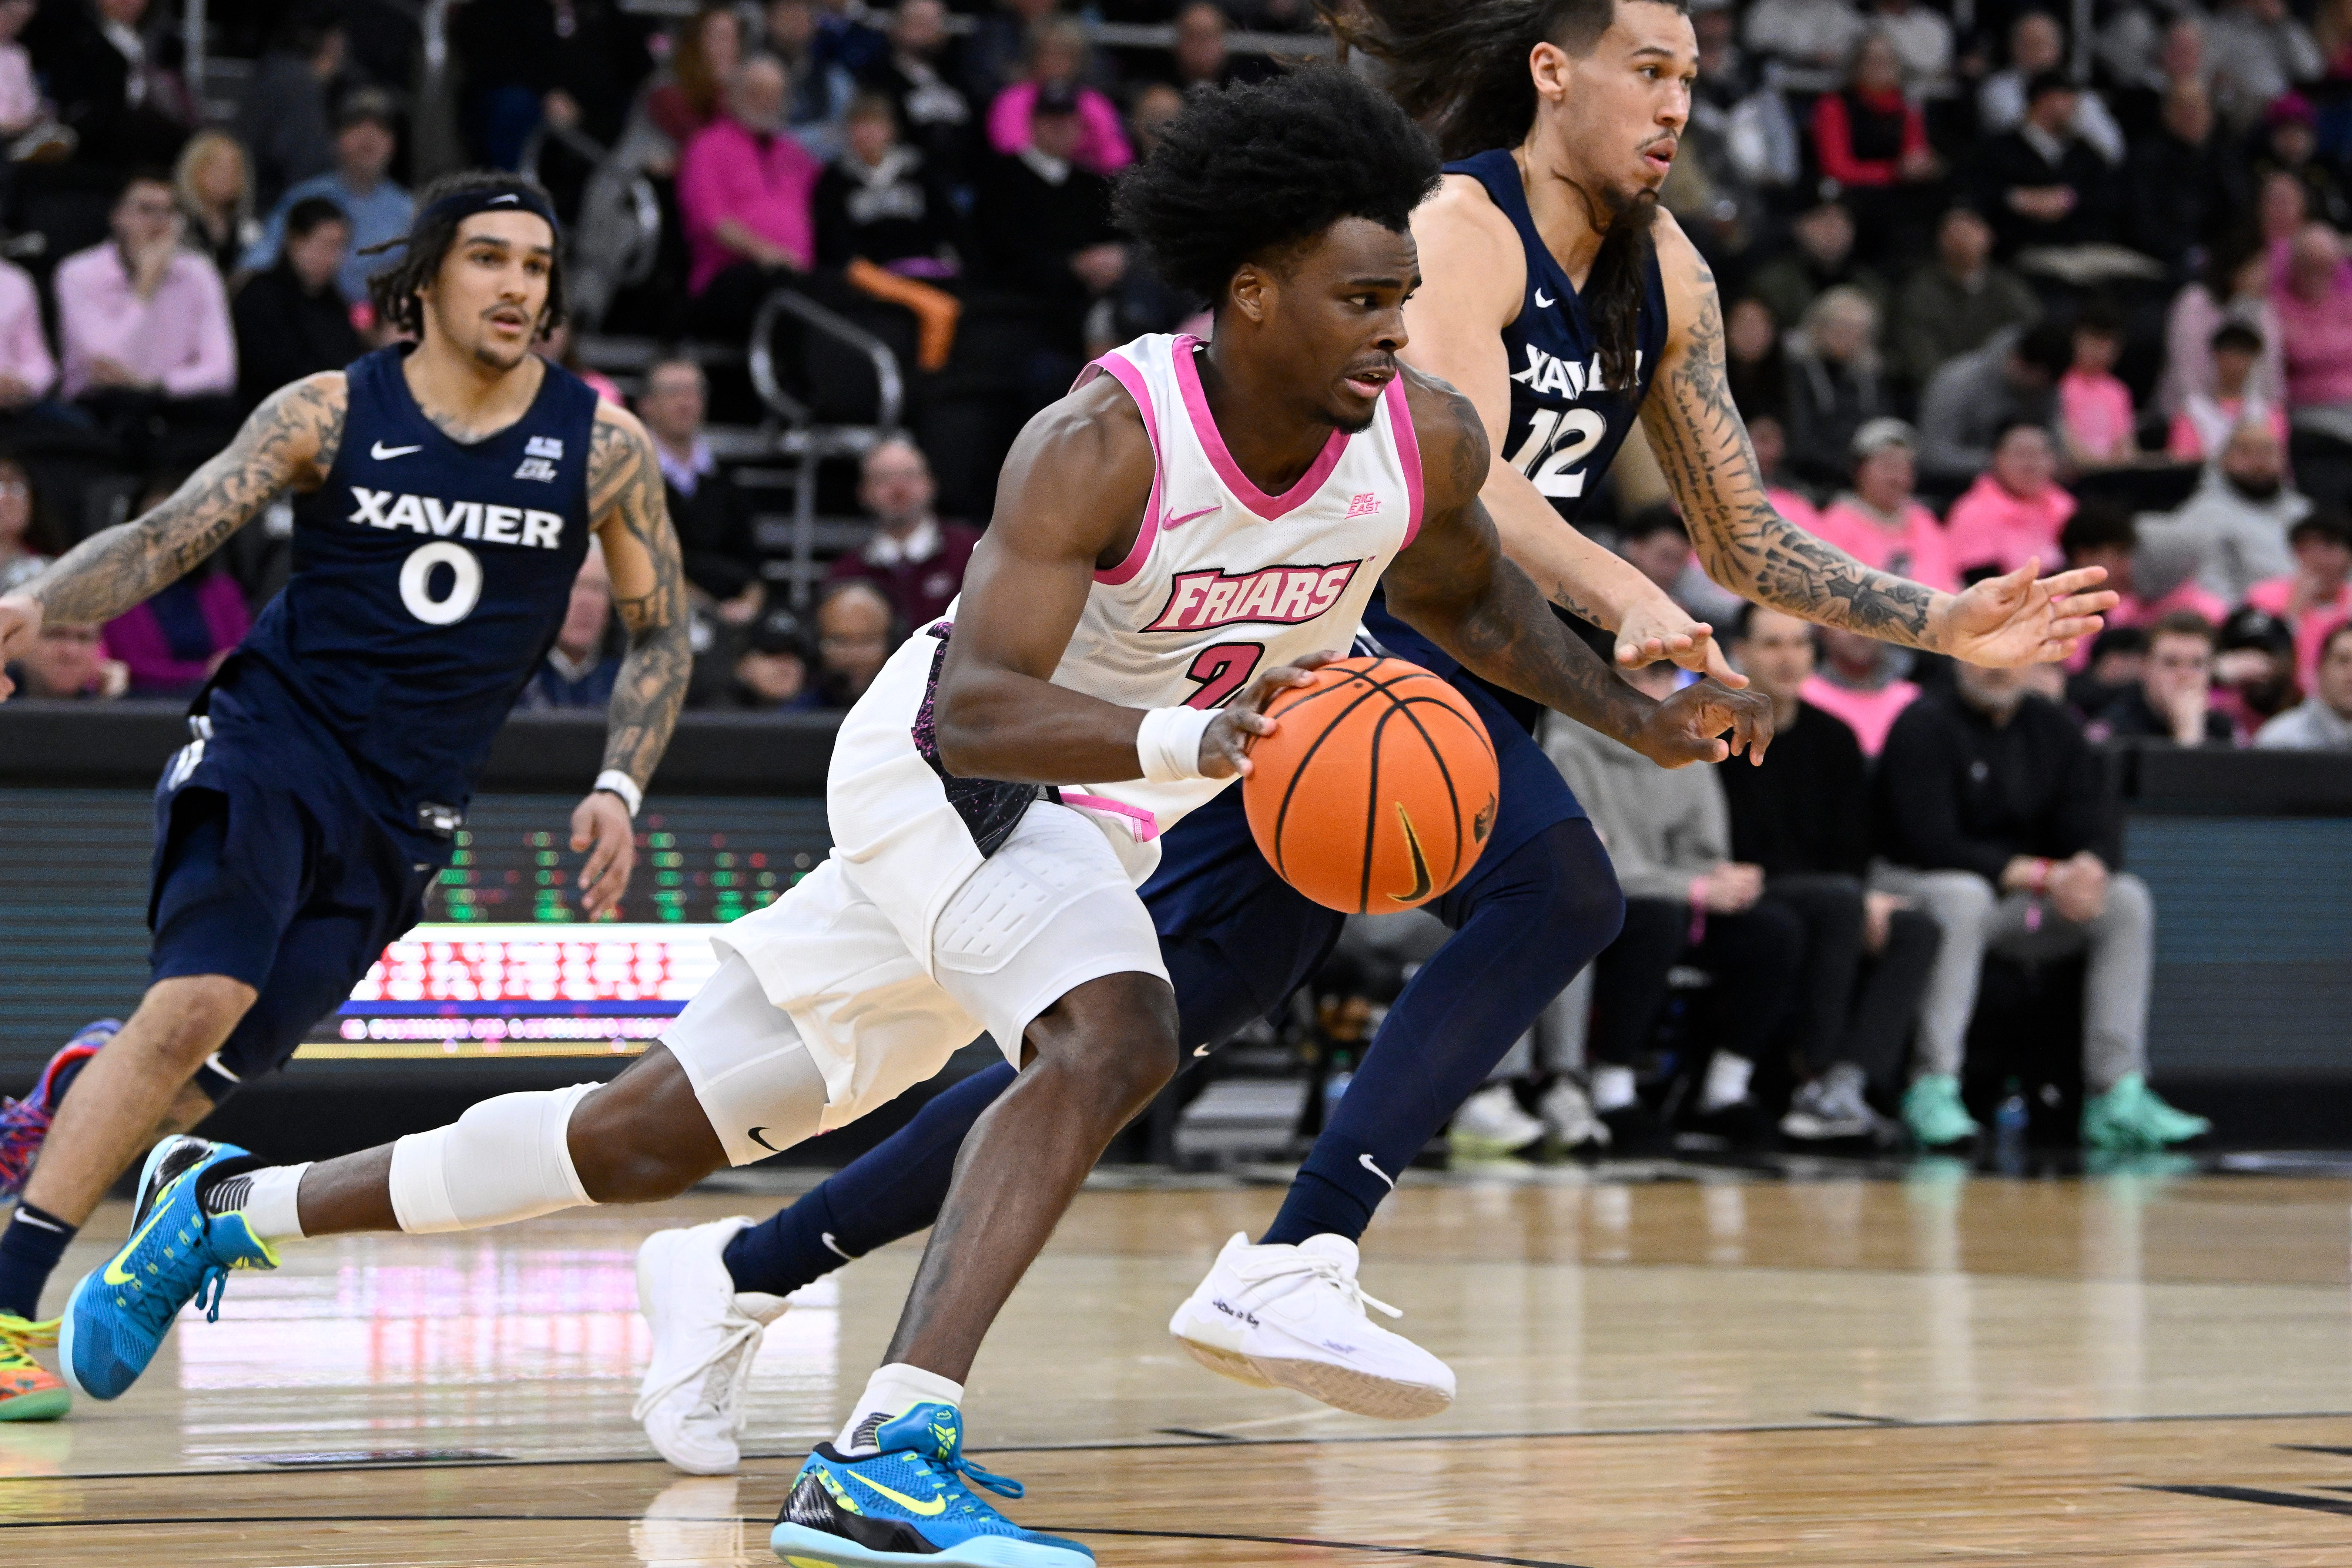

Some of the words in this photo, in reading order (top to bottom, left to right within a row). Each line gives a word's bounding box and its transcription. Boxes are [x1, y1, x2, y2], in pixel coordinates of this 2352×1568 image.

[1510, 343, 1643, 400] XAV
[1508, 408, 1607, 497] 12
[347, 486, 564, 549] XAVIER
[1347, 501, 1381, 514] EAST
[1351, 493, 1374, 505] BIG
[399, 541, 482, 625] 0
[1151, 564, 1353, 629] FRIARS
[1179, 642, 1265, 709] 2
